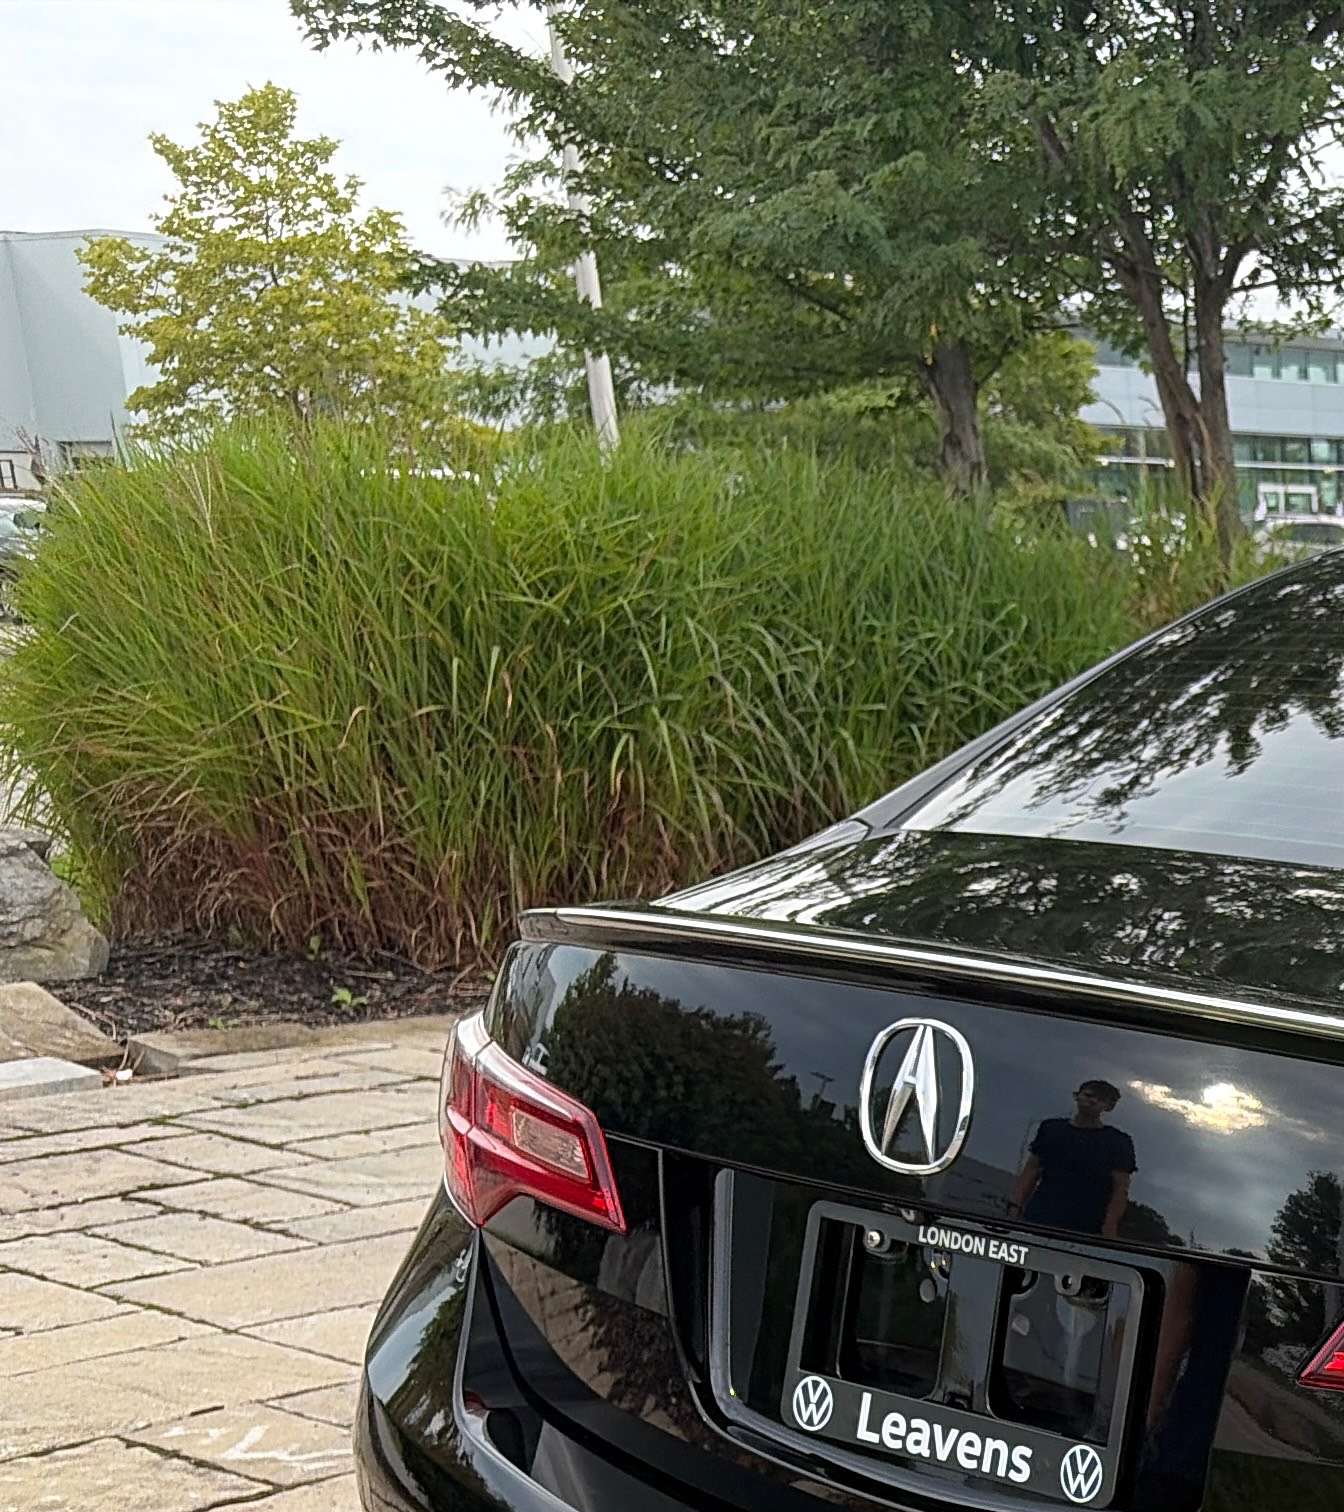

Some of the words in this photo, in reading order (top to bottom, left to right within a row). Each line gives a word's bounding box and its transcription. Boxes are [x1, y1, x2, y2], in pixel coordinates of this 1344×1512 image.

[918, 1225, 986, 1257] LONDON
[988, 1239, 1029, 1266] EAST
[793, 1375, 833, 1432] VW
[856, 1391, 1034, 1484] Leavens
[1060, 1444, 1103, 1505] VW
